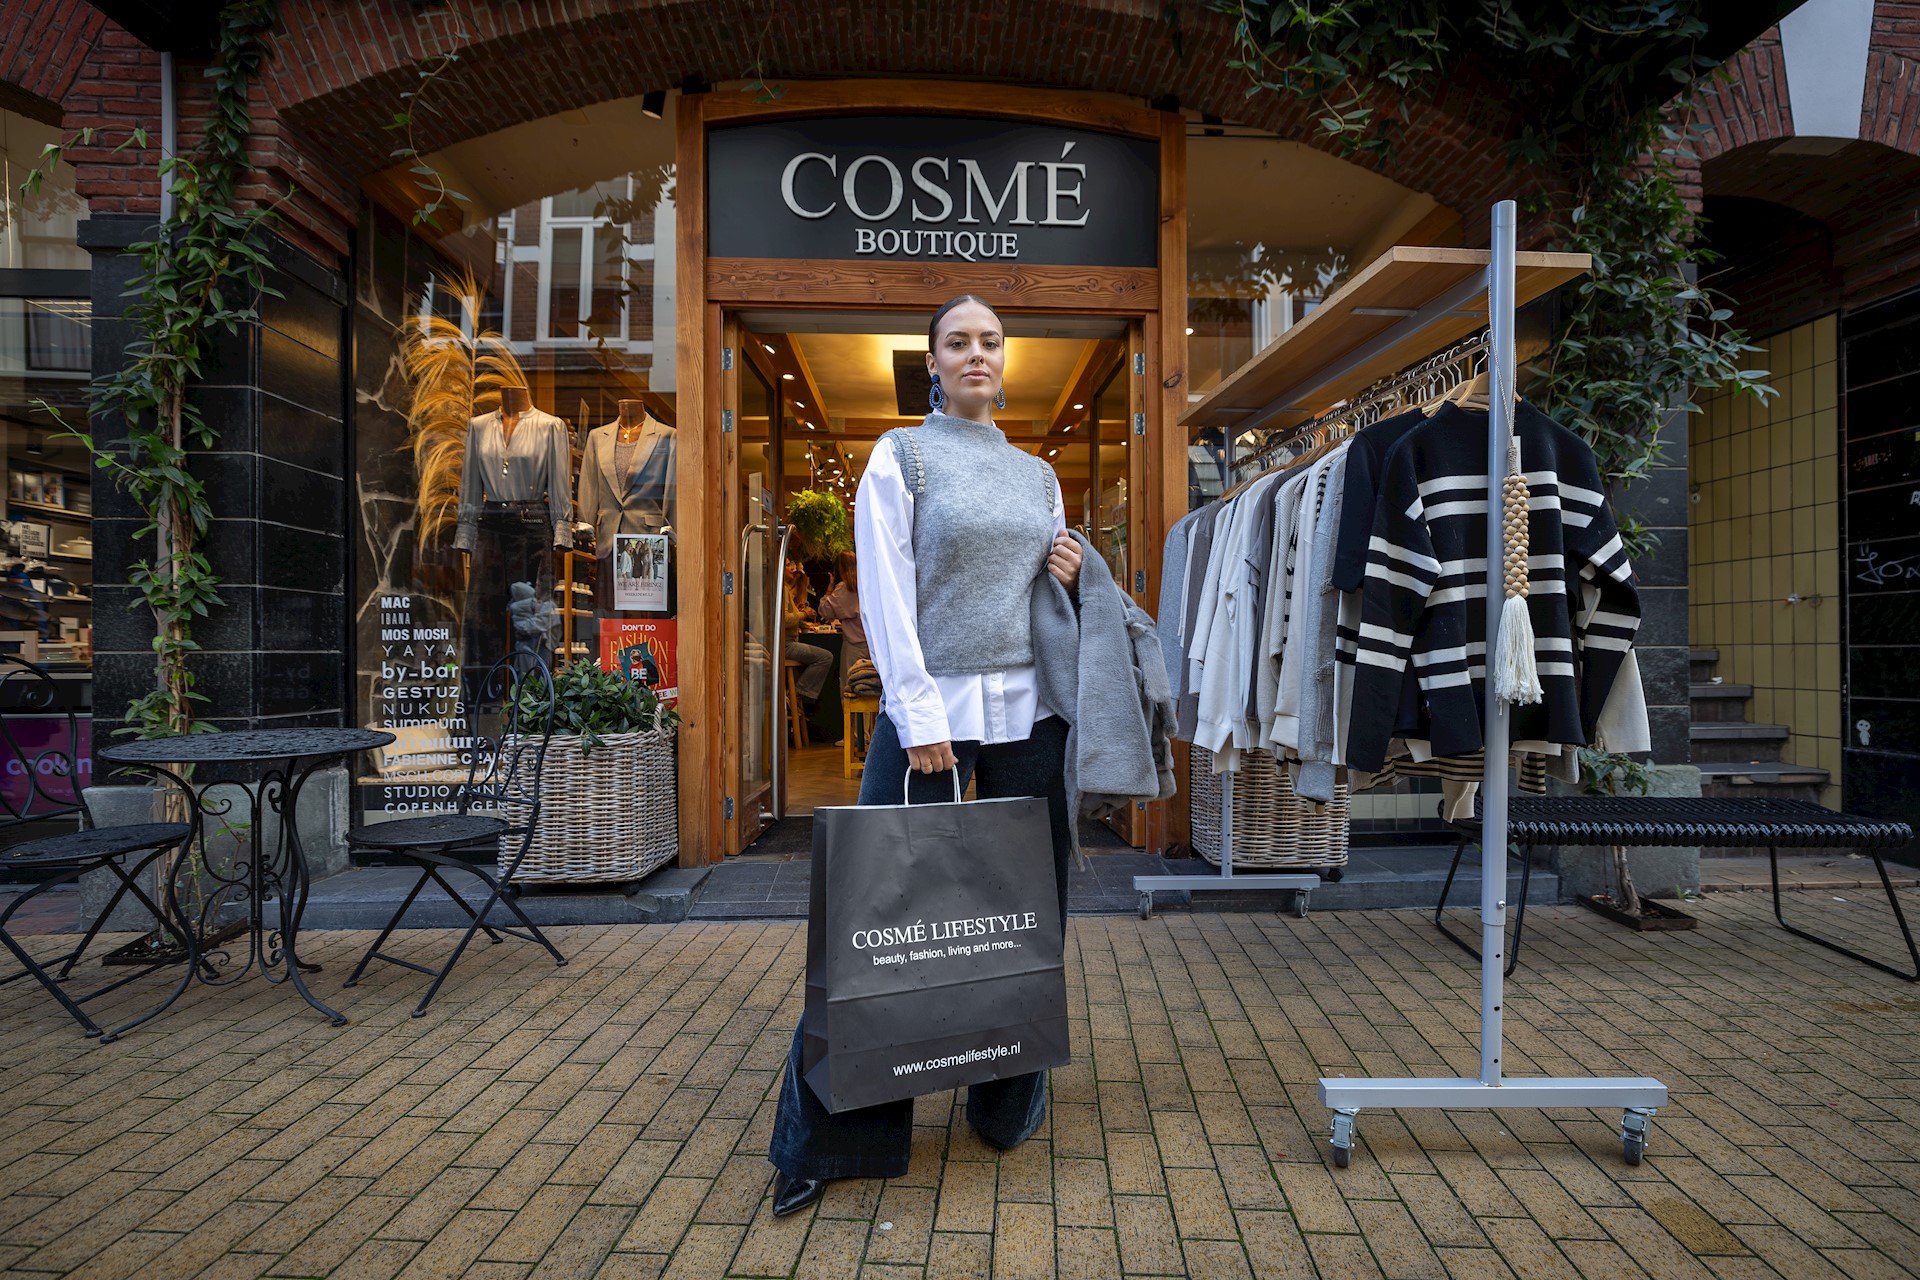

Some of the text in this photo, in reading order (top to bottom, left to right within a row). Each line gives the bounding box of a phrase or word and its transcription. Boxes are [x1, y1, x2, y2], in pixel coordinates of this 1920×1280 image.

[781, 141, 1090, 226] COSMÉ
[855, 228, 1019, 262] BOUTIQUE
[381, 597, 410, 609] MAC
[381, 613, 411, 625] IBANA
[381, 628, 449, 641] MOS MOSH
[382, 645, 456, 657] YAYA
[631, 668, 647, 680] BE
[383, 687, 460, 699] GESTUZ
[383, 702, 465, 715] NUKUS
[383, 718, 467, 731] summum
[384, 753, 458, 766] FABIENNE
[384, 785, 450, 799] STUDIO
[384, 800, 505, 814] COPENHGEN
[852, 911, 1038, 950] COSMÉ LIFESTYLE
[873, 940, 1022, 966] beauty, fashion, living and more...
[893, 1041, 1021, 1077] www.cosmelifestyle.nl
